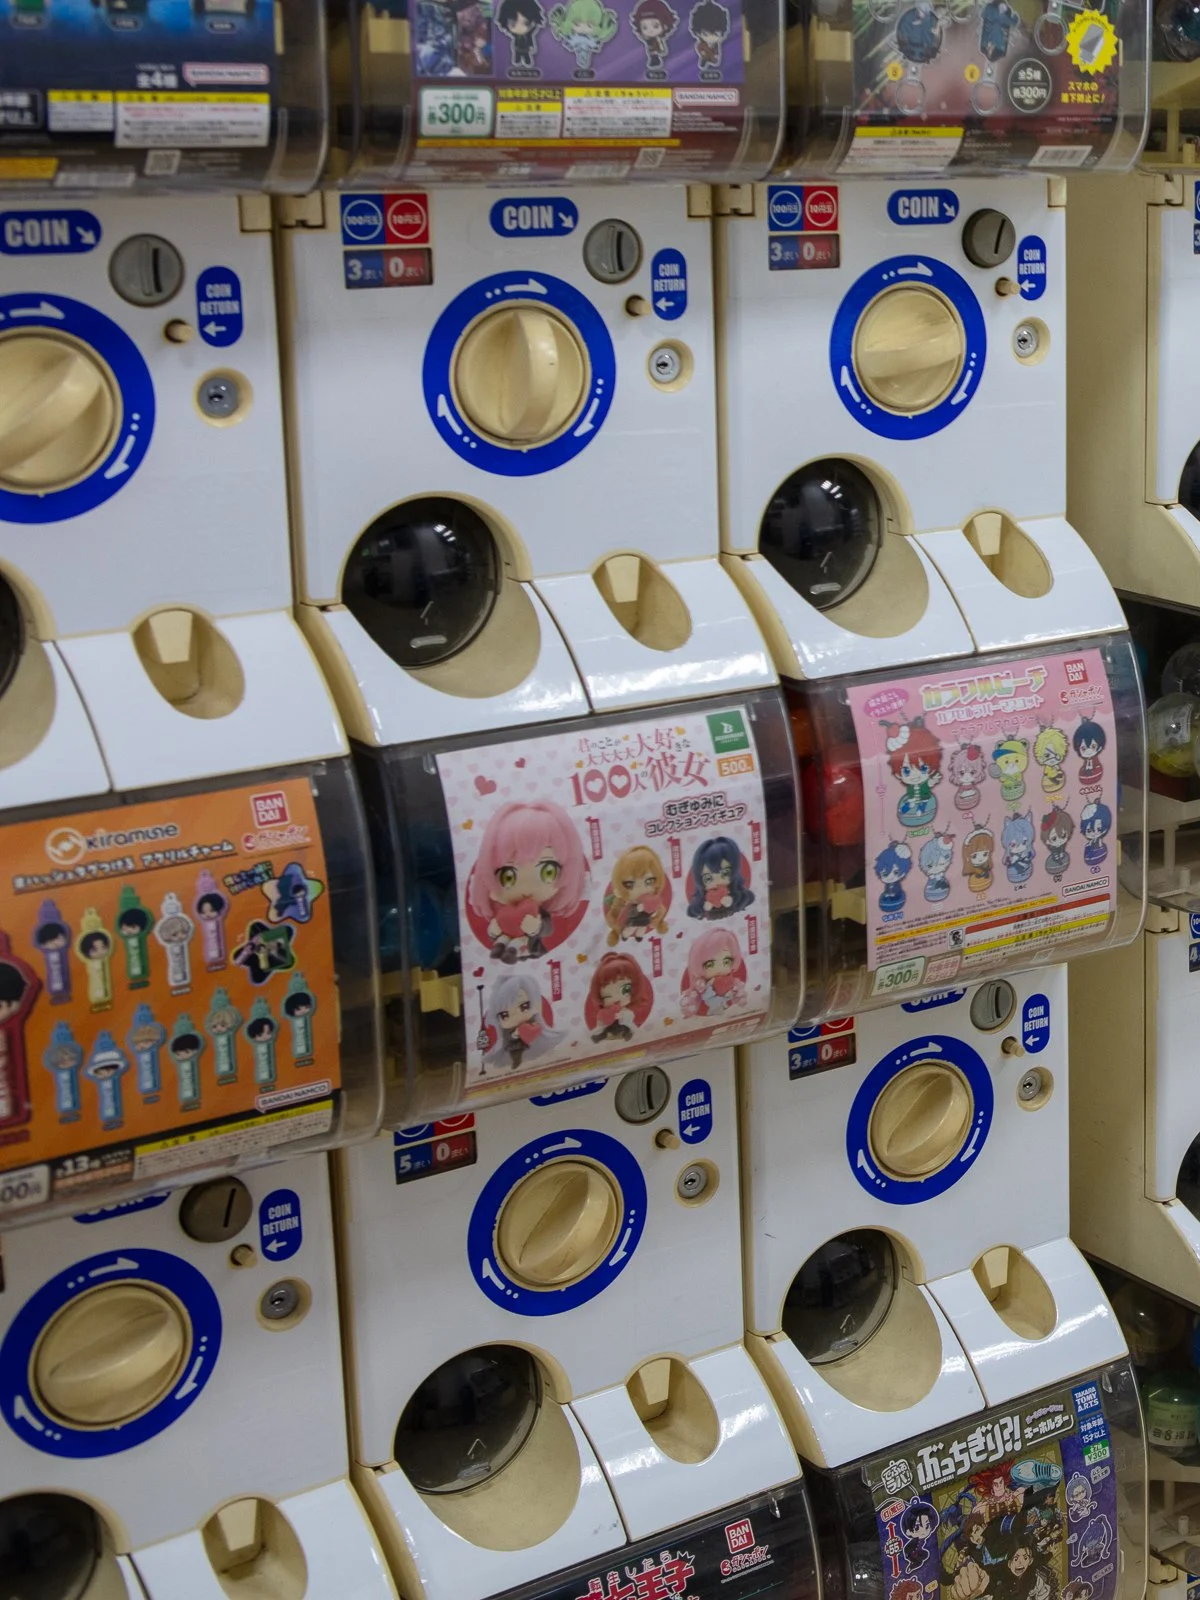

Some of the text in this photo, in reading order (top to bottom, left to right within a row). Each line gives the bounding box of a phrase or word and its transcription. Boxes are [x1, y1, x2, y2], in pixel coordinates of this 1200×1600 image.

[898, 196, 940, 218] COIN
[503, 205, 555, 230] COIN
[3, 219, 70, 247] COIN
[1023, 249, 1042, 262] COIN
[659, 263, 680, 277] COIN
[1018, 262, 1046, 275] RETURN
[205, 282, 232, 299] COIN
[654, 278, 686, 292] RETURN
[200, 301, 241, 315] RETURN
[1066, 663, 1085, 673] BAN
[1067, 672, 1084, 683] DAI
[921, 666, 1048, 711] カラフルピーチ
[568, 751, 711, 807] 100人の彼女
[255, 797, 283, 811] BAN
[665, 795, 725, 816] むぎゅみに
[258, 809, 281, 824] DAI
[647, 807, 744, 835] コレクションフィギュア
[1064, 878, 1108, 895] BANDAI NAMCO
[1028, 1005, 1045, 1018] COIN
[1023, 1016, 1049, 1033] RETURN
[686, 1091, 704, 1107] COIN
[680, 1104, 711, 1121] RETURN
[267, 1204, 292, 1220] COIN
[262, 1217, 300, 1237] RETURN
[1074, 1387, 1096, 1399] TAKARA
[1075, 1393, 1098, 1406] TOMY
[1024, 1414, 1070, 1440] キーホルダー
[1087, 1449, 1108, 1461] ¥300
[922, 1474, 955, 1491] BUCCHIGIRI
[729, 1524, 750, 1538] BAN
[731, 1536, 748, 1549] DAI
[587, 1550, 674, 1594] 転生したら
